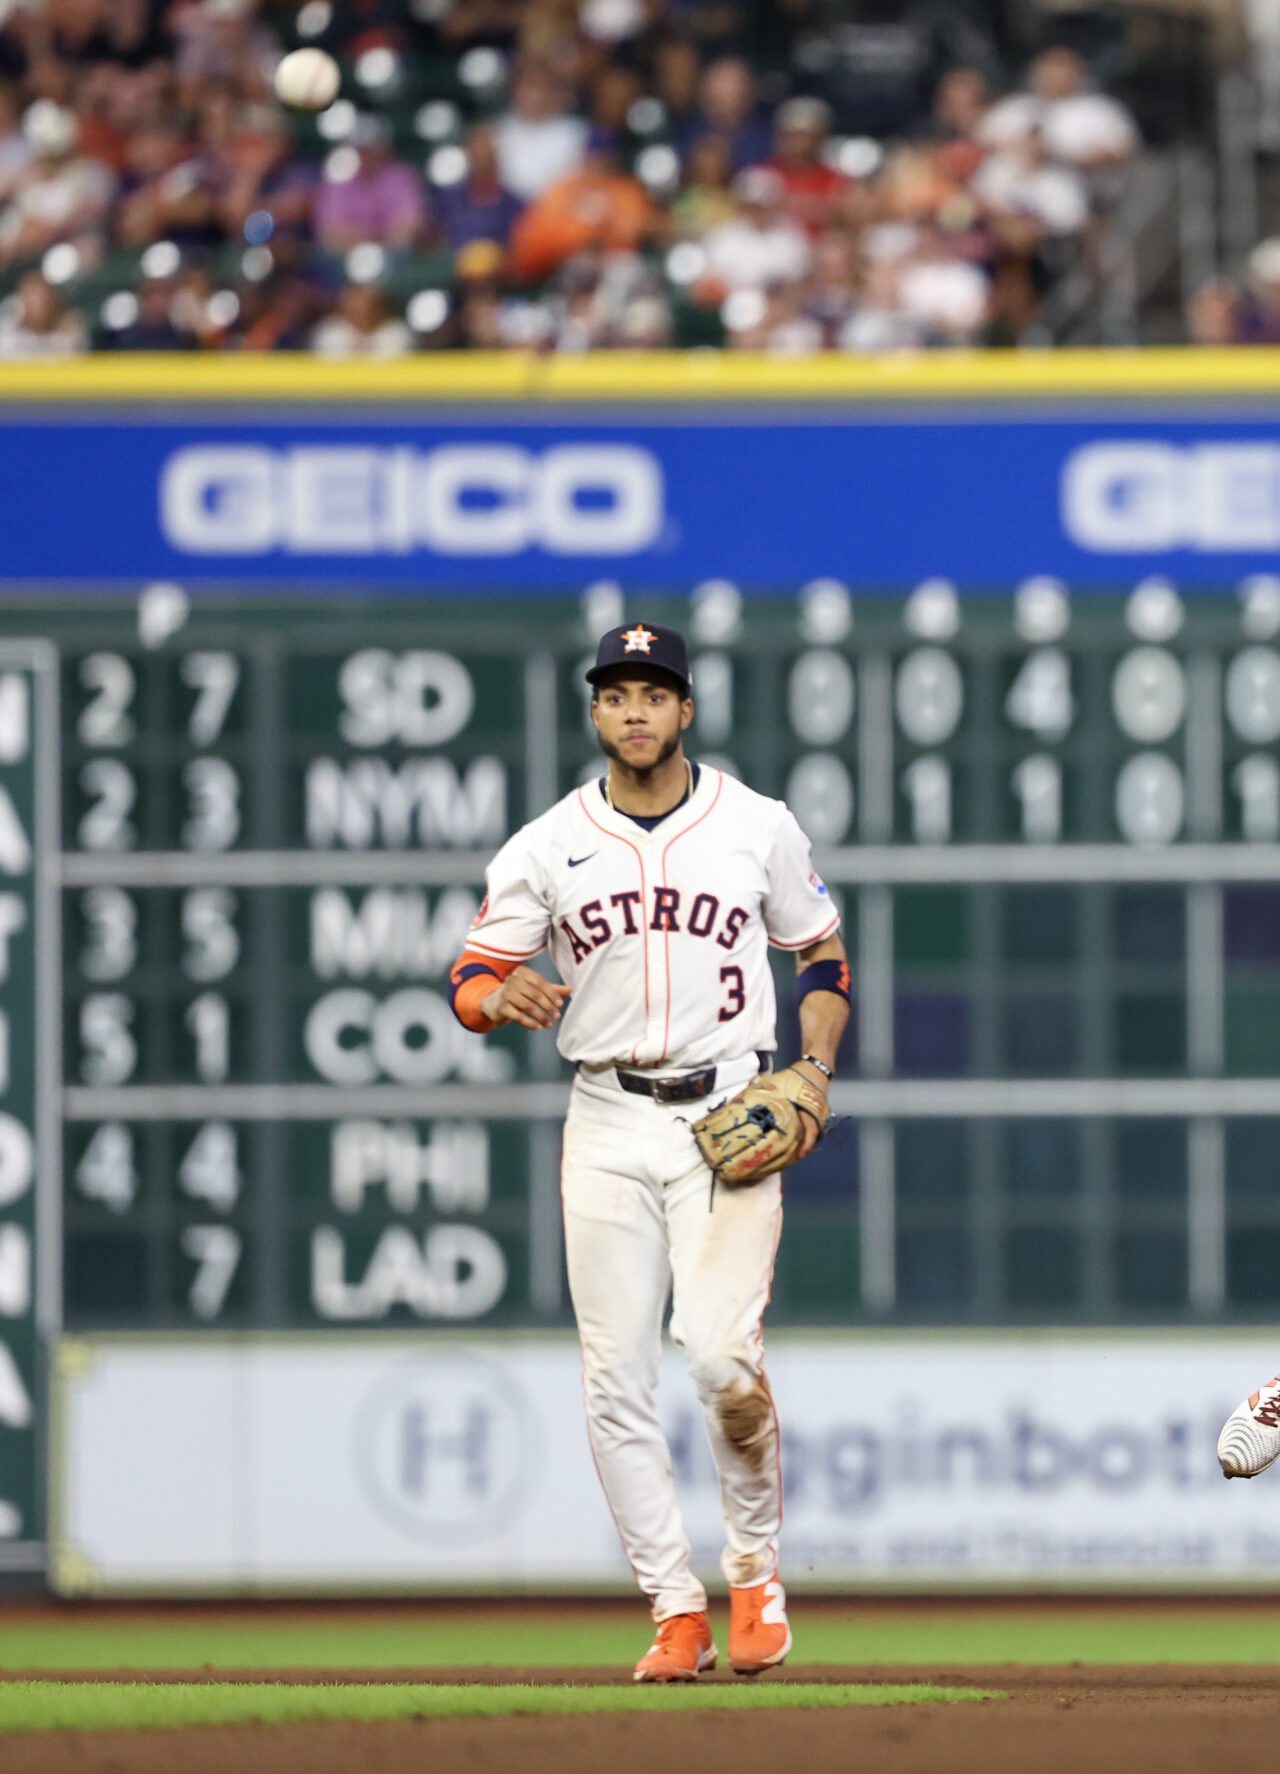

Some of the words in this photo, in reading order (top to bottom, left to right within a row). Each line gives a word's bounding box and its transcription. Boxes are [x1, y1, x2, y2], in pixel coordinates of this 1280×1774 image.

[161, 445, 663, 555] GEICO
[339, 648, 474, 748] SD
[789, 648, 854, 746] 0
[896, 647, 962, 745] 0
[1005, 647, 1074, 742] 4
[1114, 647, 1184, 743] 0
[306, 757, 508, 848] NYM
[906, 753, 951, 845] 1
[1014, 753, 1062, 845] 1
[1116, 751, 1183, 847] 0
[561, 886, 750, 965] ASTROS
[718, 965, 746, 1023] 3
[331, 1119, 490, 1213] PHI
[311, 1223, 508, 1320] LAD
[402, 1401, 493, 1501] H
